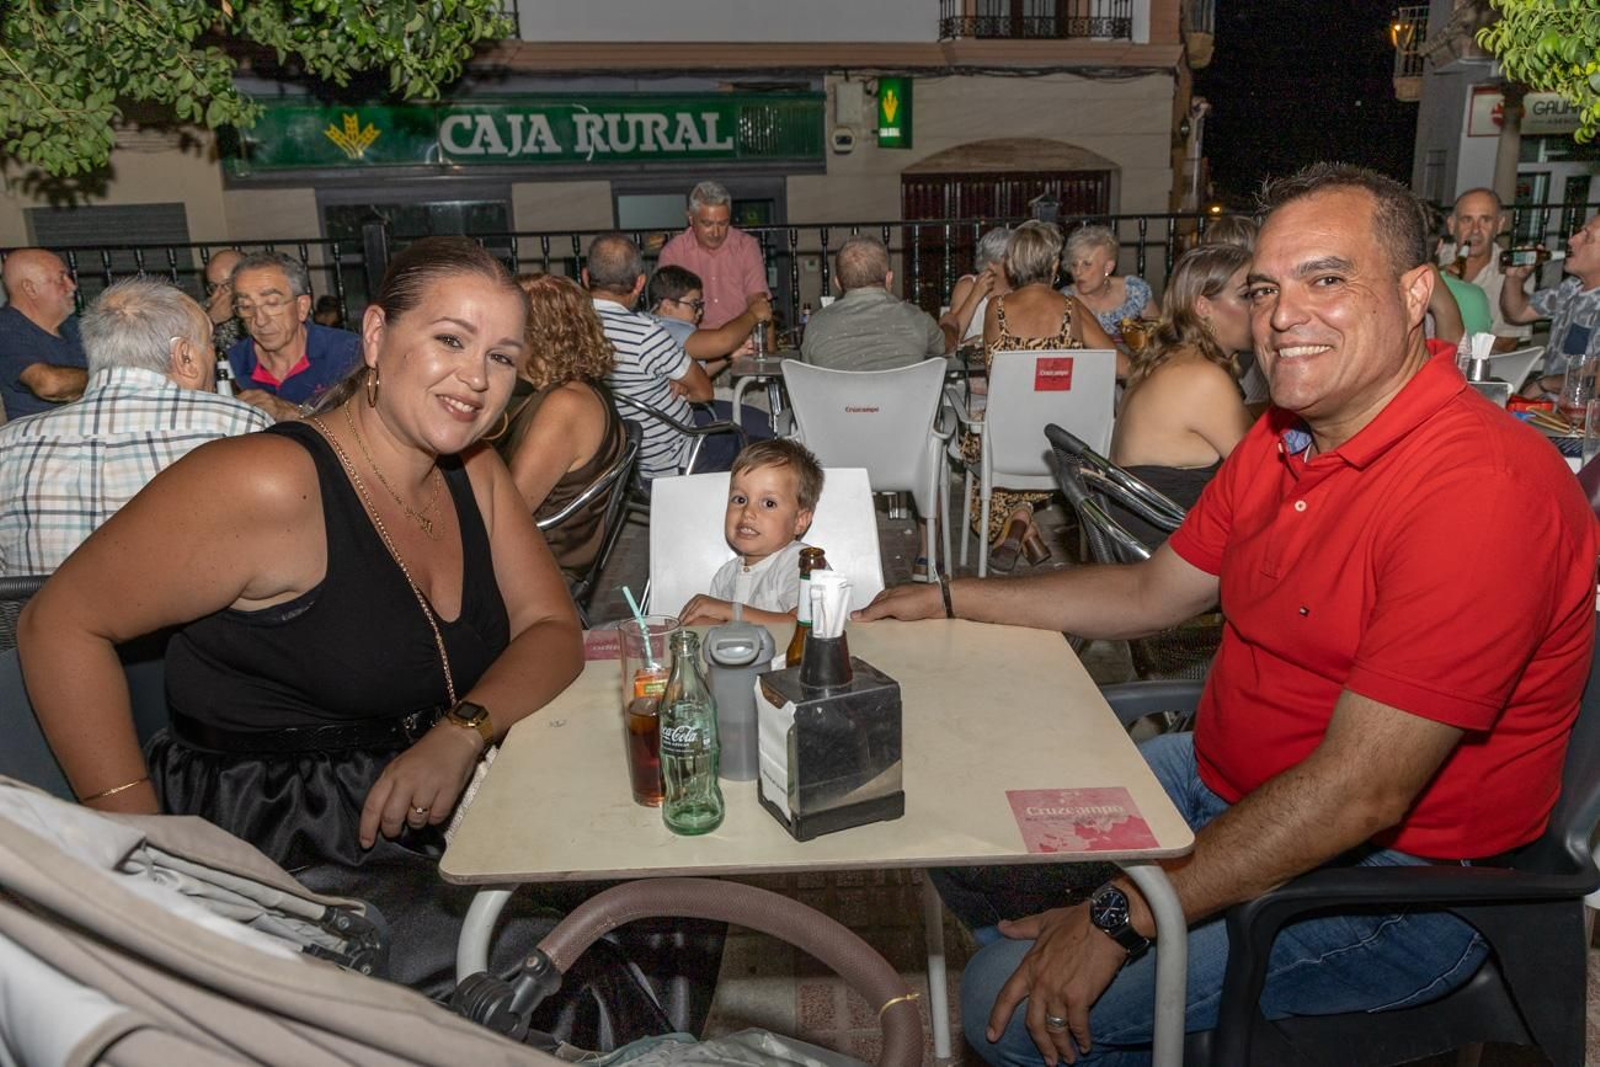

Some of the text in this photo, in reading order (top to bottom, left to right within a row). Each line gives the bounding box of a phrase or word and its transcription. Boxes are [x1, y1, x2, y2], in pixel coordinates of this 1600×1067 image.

[440, 112, 734, 157] CAJA RURAL
[1026, 804, 1124, 818] Cruzcampo
